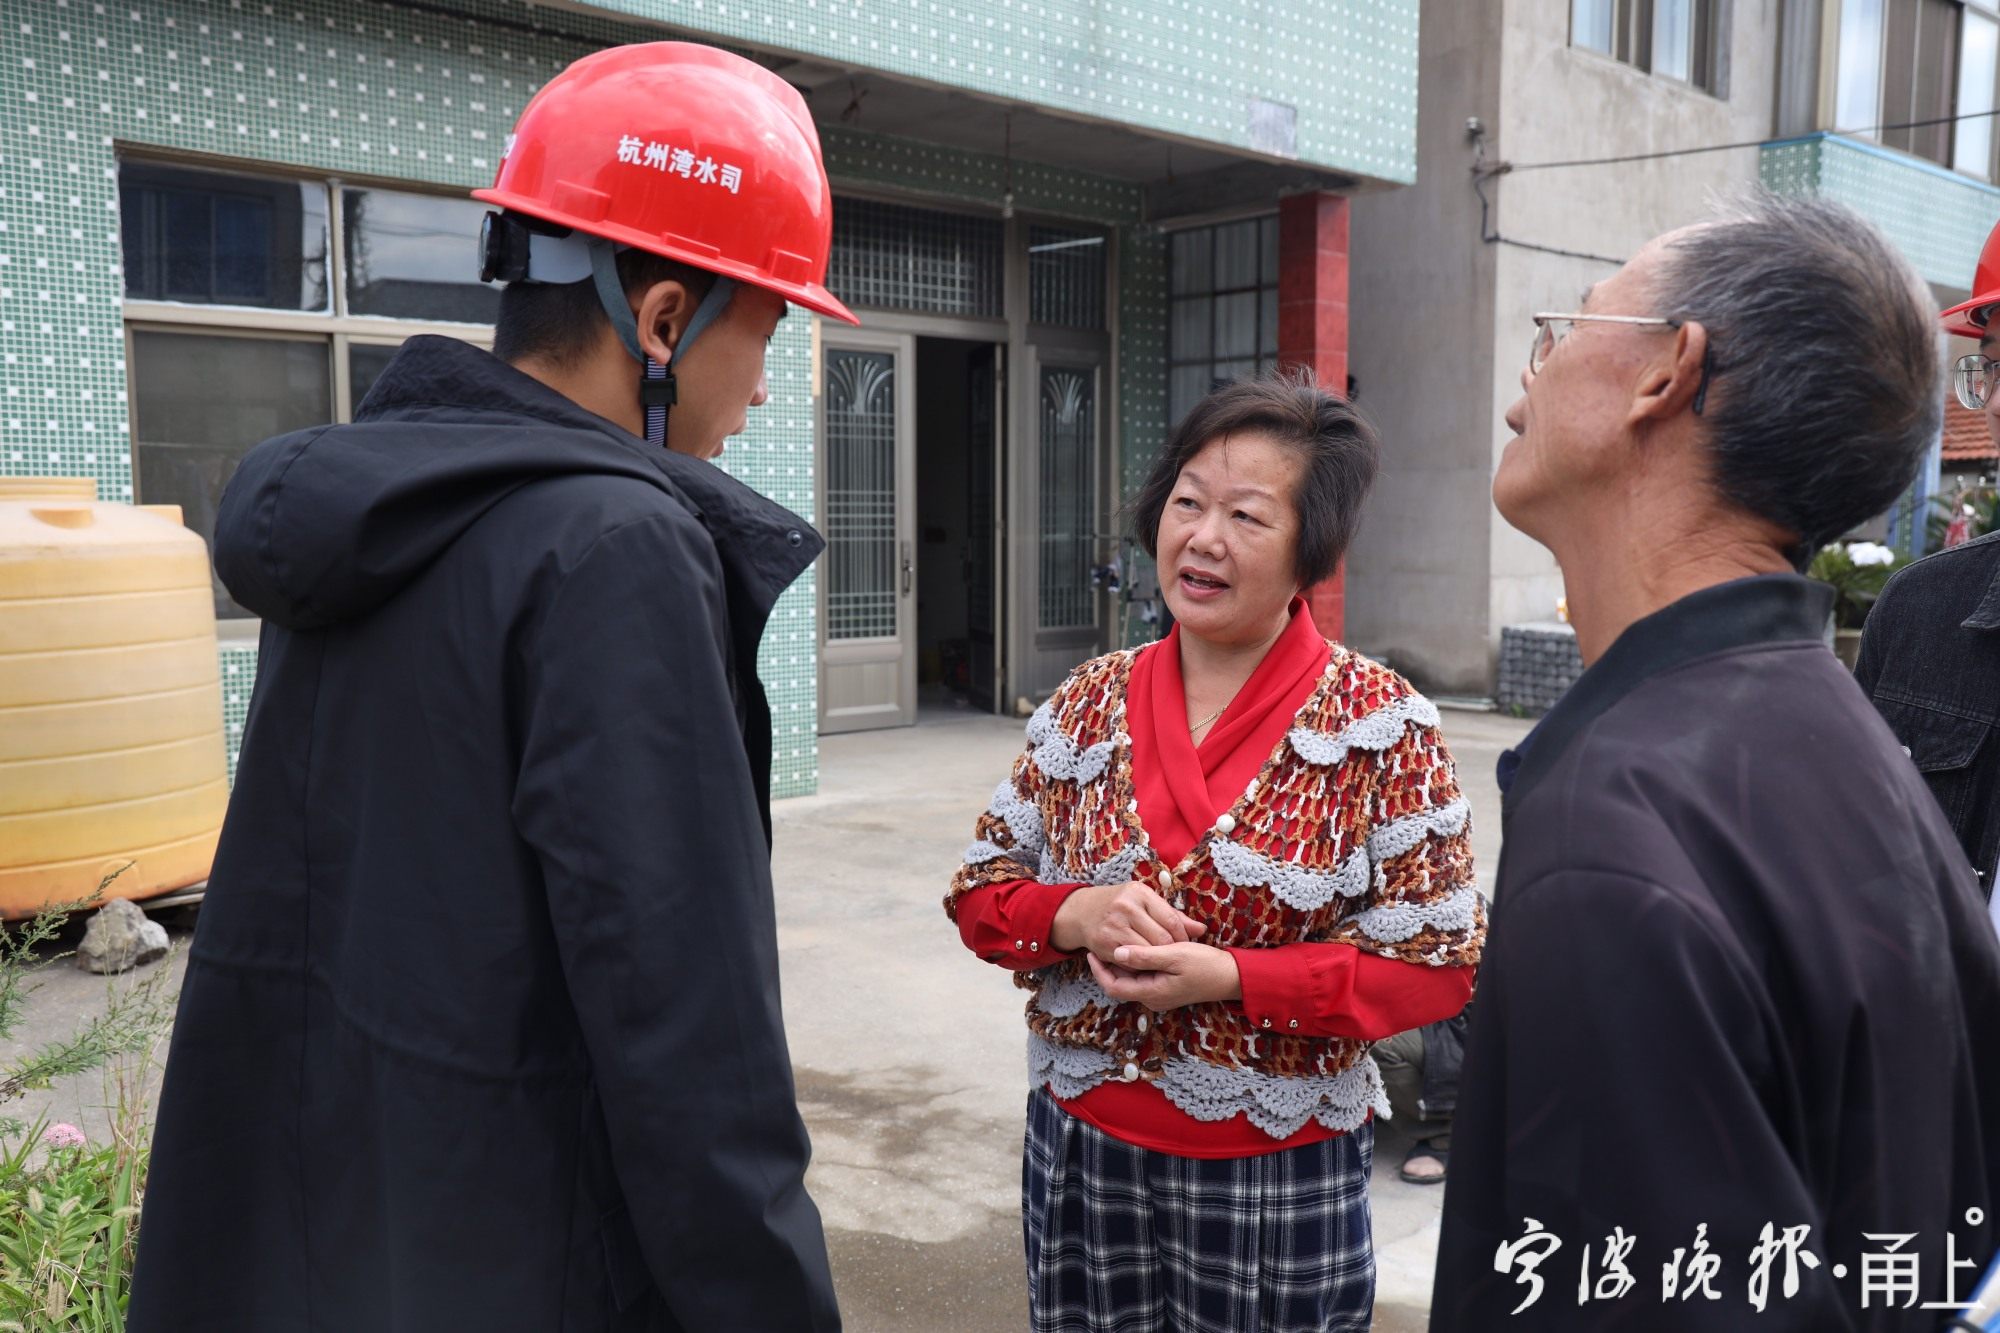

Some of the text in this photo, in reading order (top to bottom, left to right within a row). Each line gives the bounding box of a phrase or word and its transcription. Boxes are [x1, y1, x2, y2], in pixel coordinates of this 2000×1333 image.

[617, 134, 743, 195] 杭州湾水司
